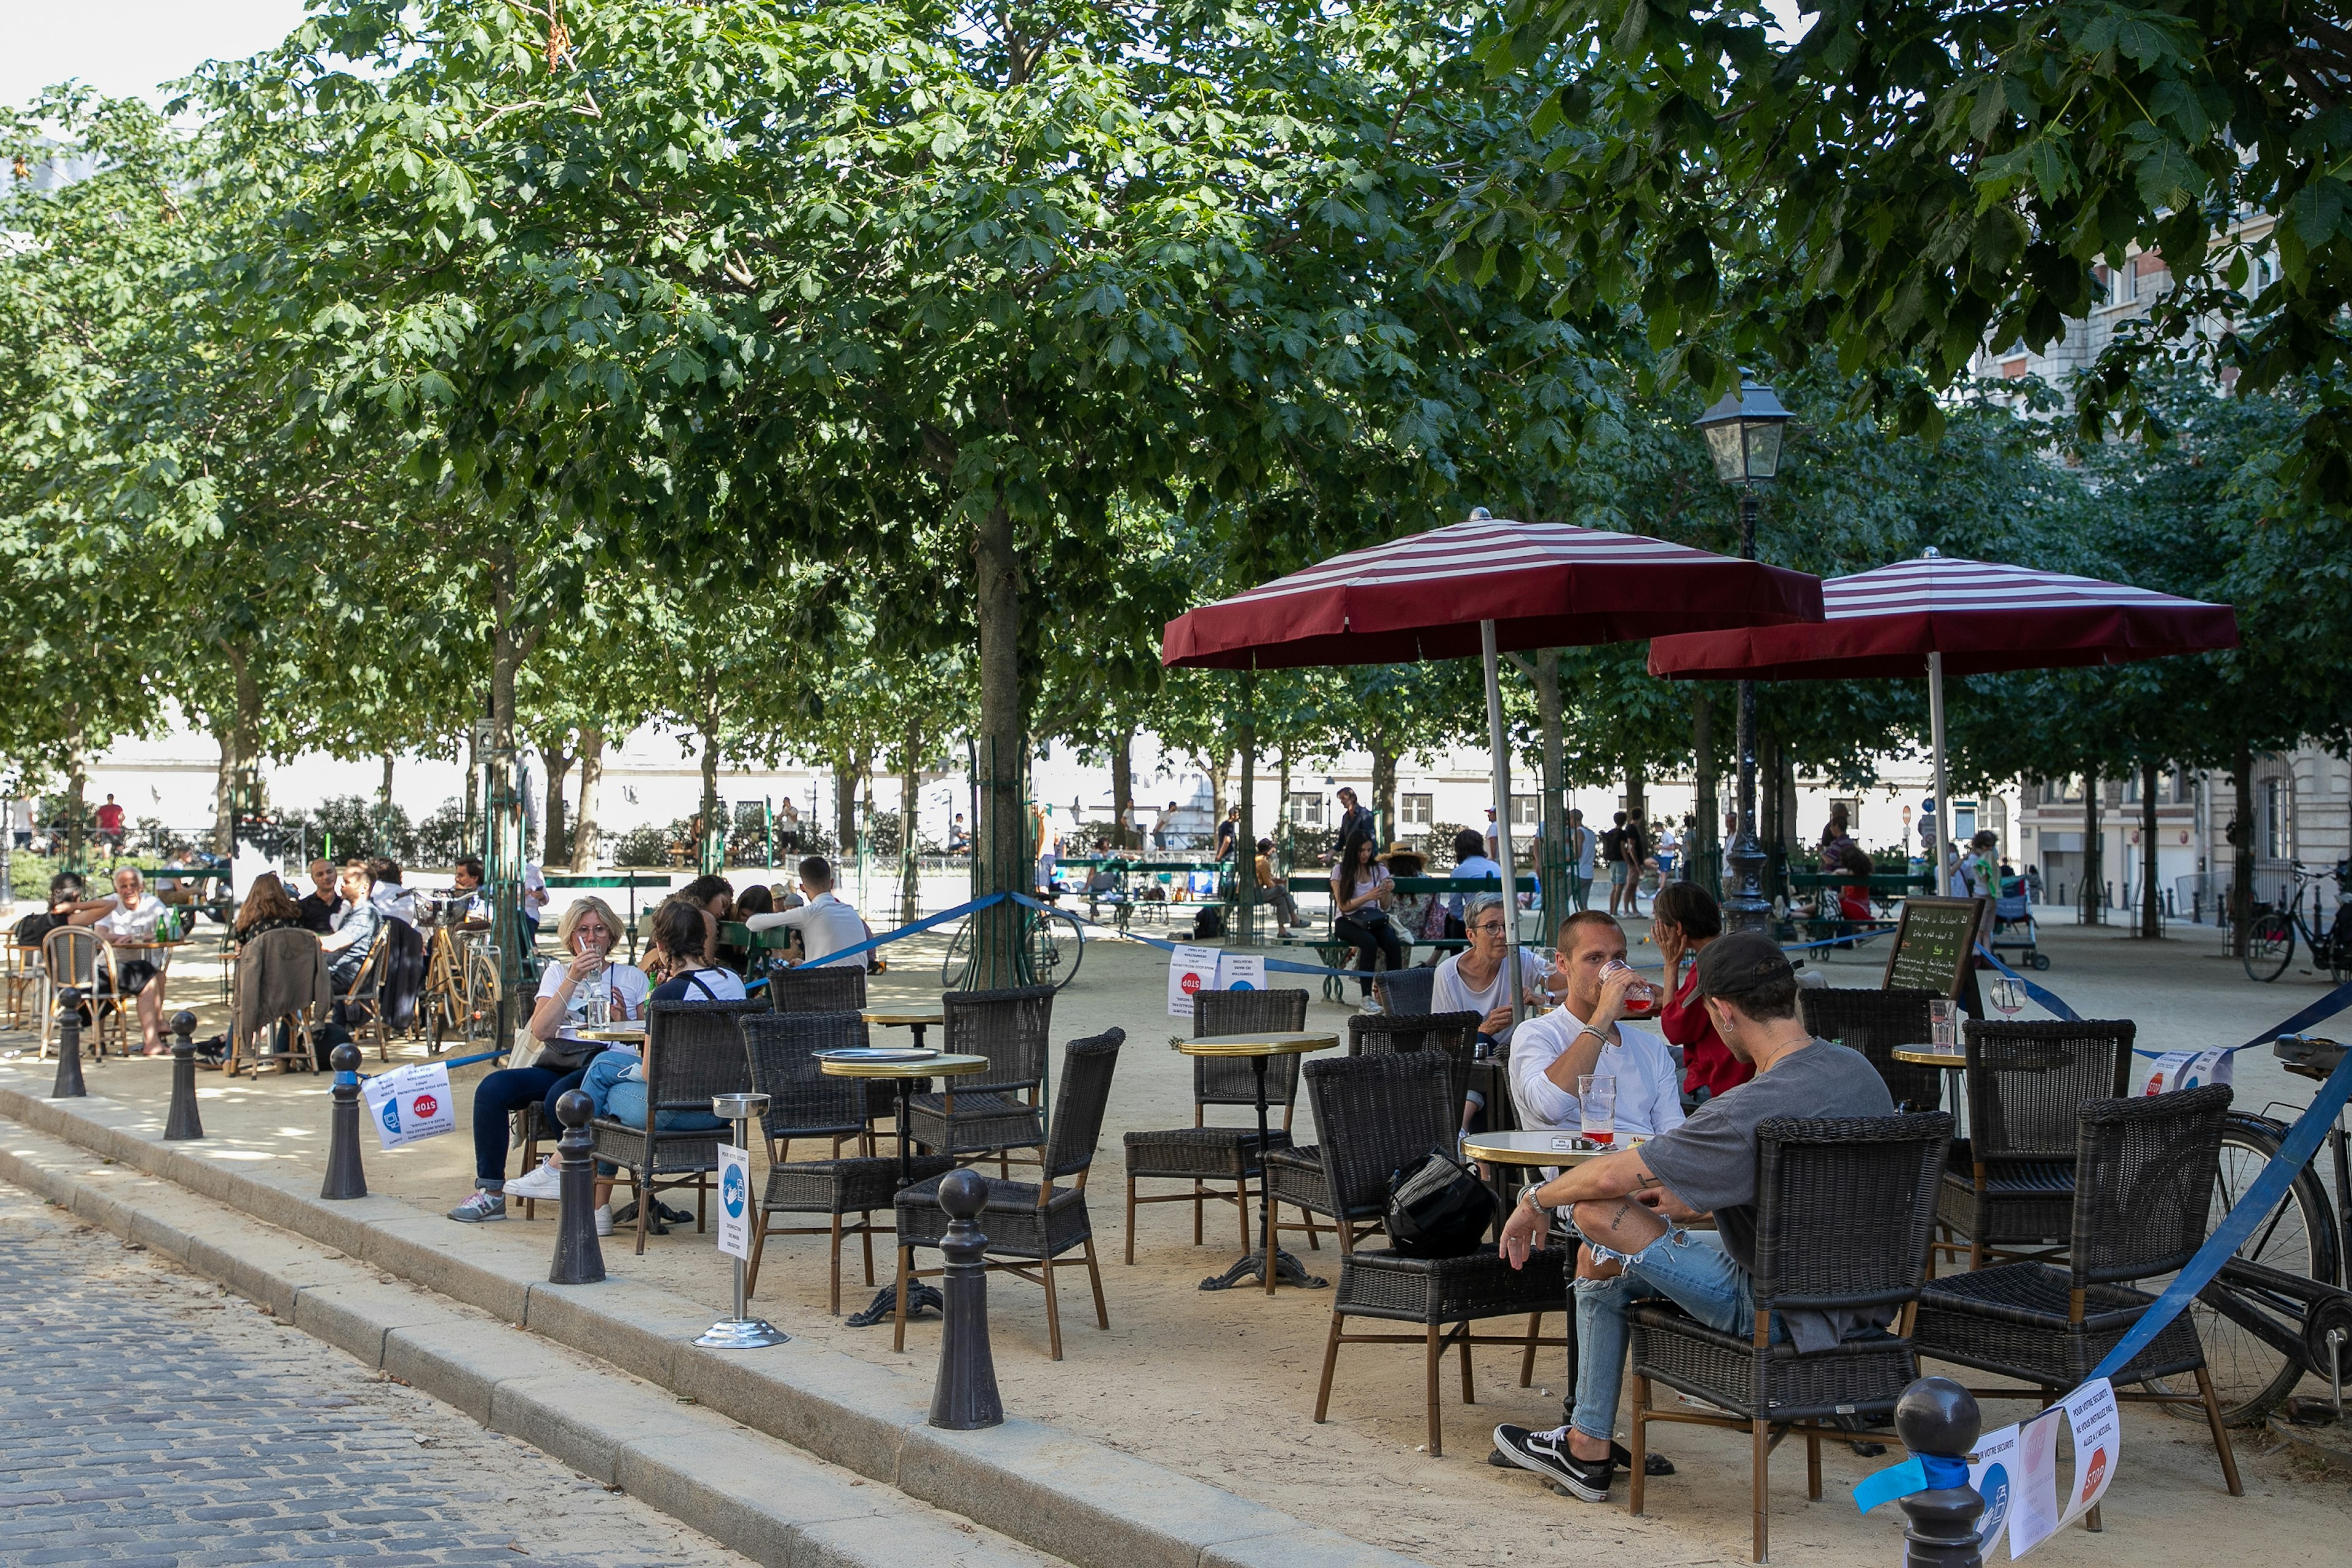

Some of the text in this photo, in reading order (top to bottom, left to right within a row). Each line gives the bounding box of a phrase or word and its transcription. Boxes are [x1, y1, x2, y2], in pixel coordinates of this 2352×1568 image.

[2149, 1083, 2160, 1092] STOP
[414, 1101, 436, 1112] STOP
[2073, 1406, 2083, 1418] POUR
[2082, 1398, 2094, 1412] VOTRE
[2093, 1388, 2109, 1404] SECURITE
[2076, 1425, 2081, 1434] NE
[2081, 1419, 2090, 1431] VOUS
[2090, 1408, 2106, 1425] INSTALLEZ
[2083, 1435, 2093, 1448] ALLEZ
[2095, 1423, 2112, 1439] L'ACCUEIL,
[1984, 1446, 1997, 1458] VOTRE
[1997, 1439, 2014, 1453] SECURITE
[2086, 1466, 2105, 1490] STOP
